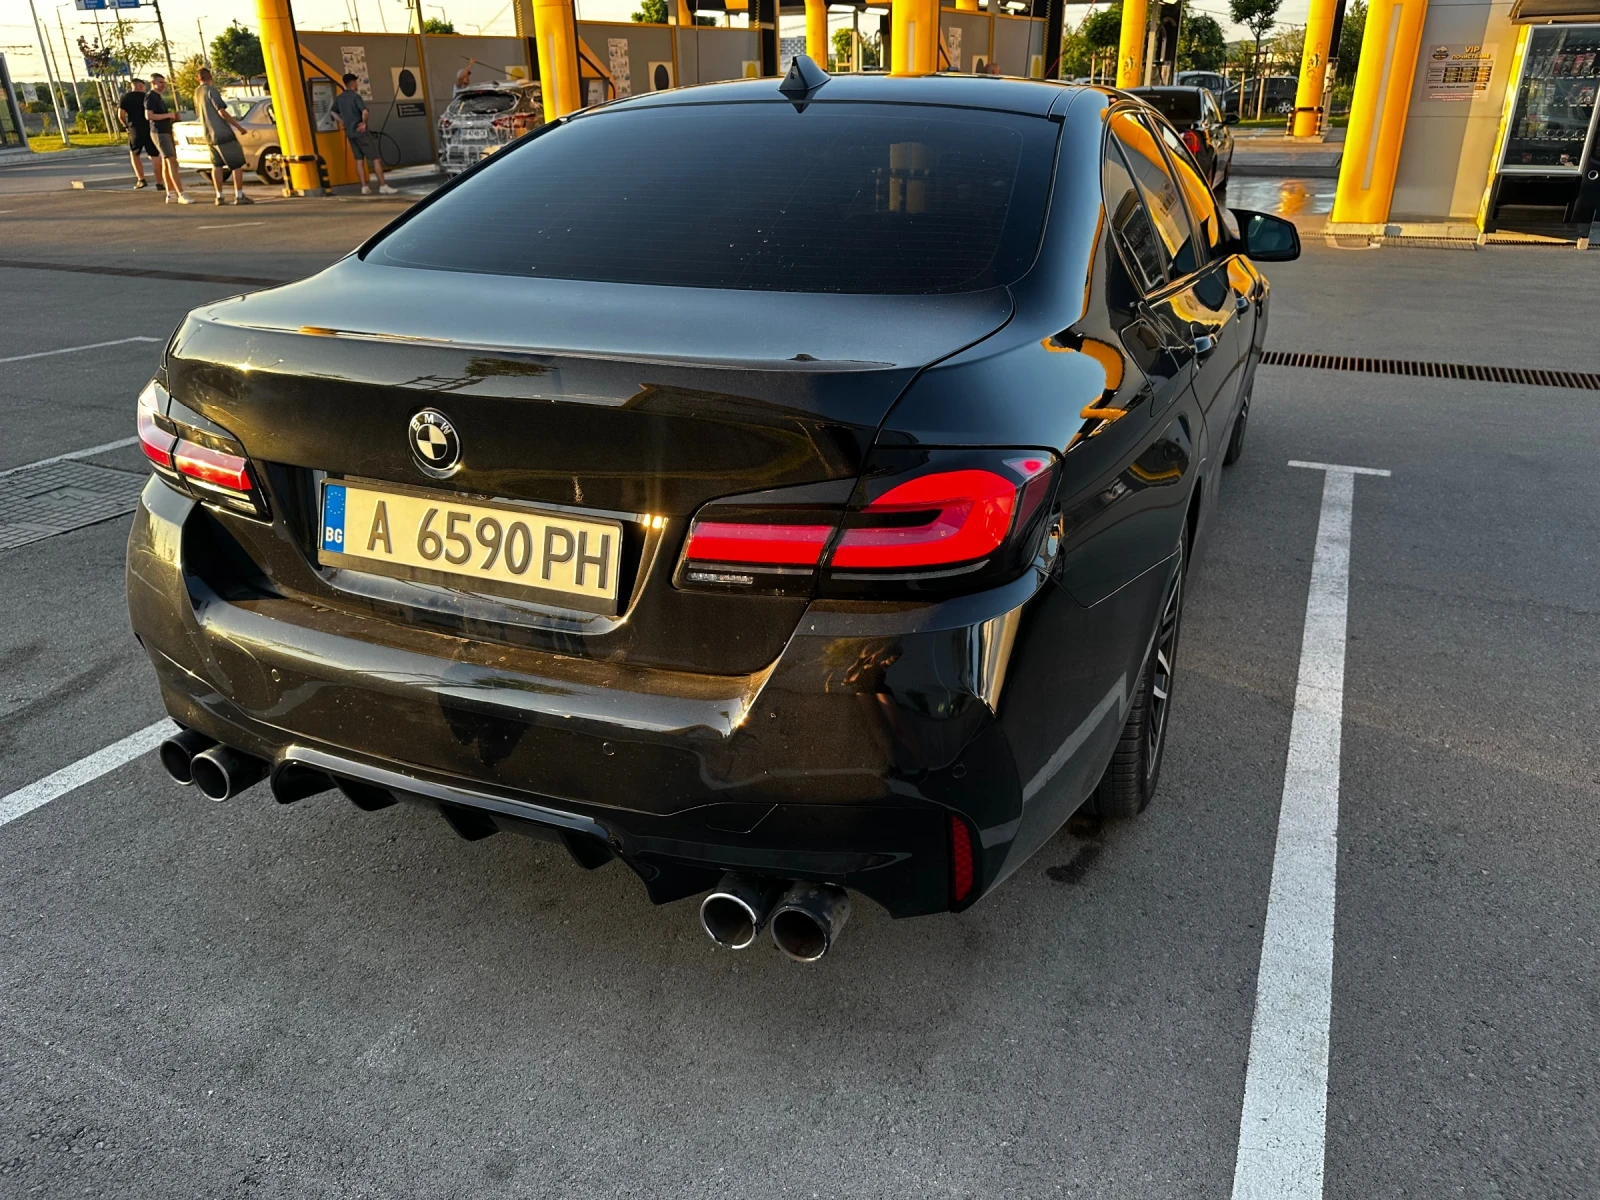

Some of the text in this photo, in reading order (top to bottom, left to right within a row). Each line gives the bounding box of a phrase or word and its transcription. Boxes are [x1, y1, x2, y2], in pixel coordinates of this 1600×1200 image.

[411, 413, 453, 435] BMW
[325, 526, 343, 544] BG
[366, 500, 611, 589] A 6590 PH
